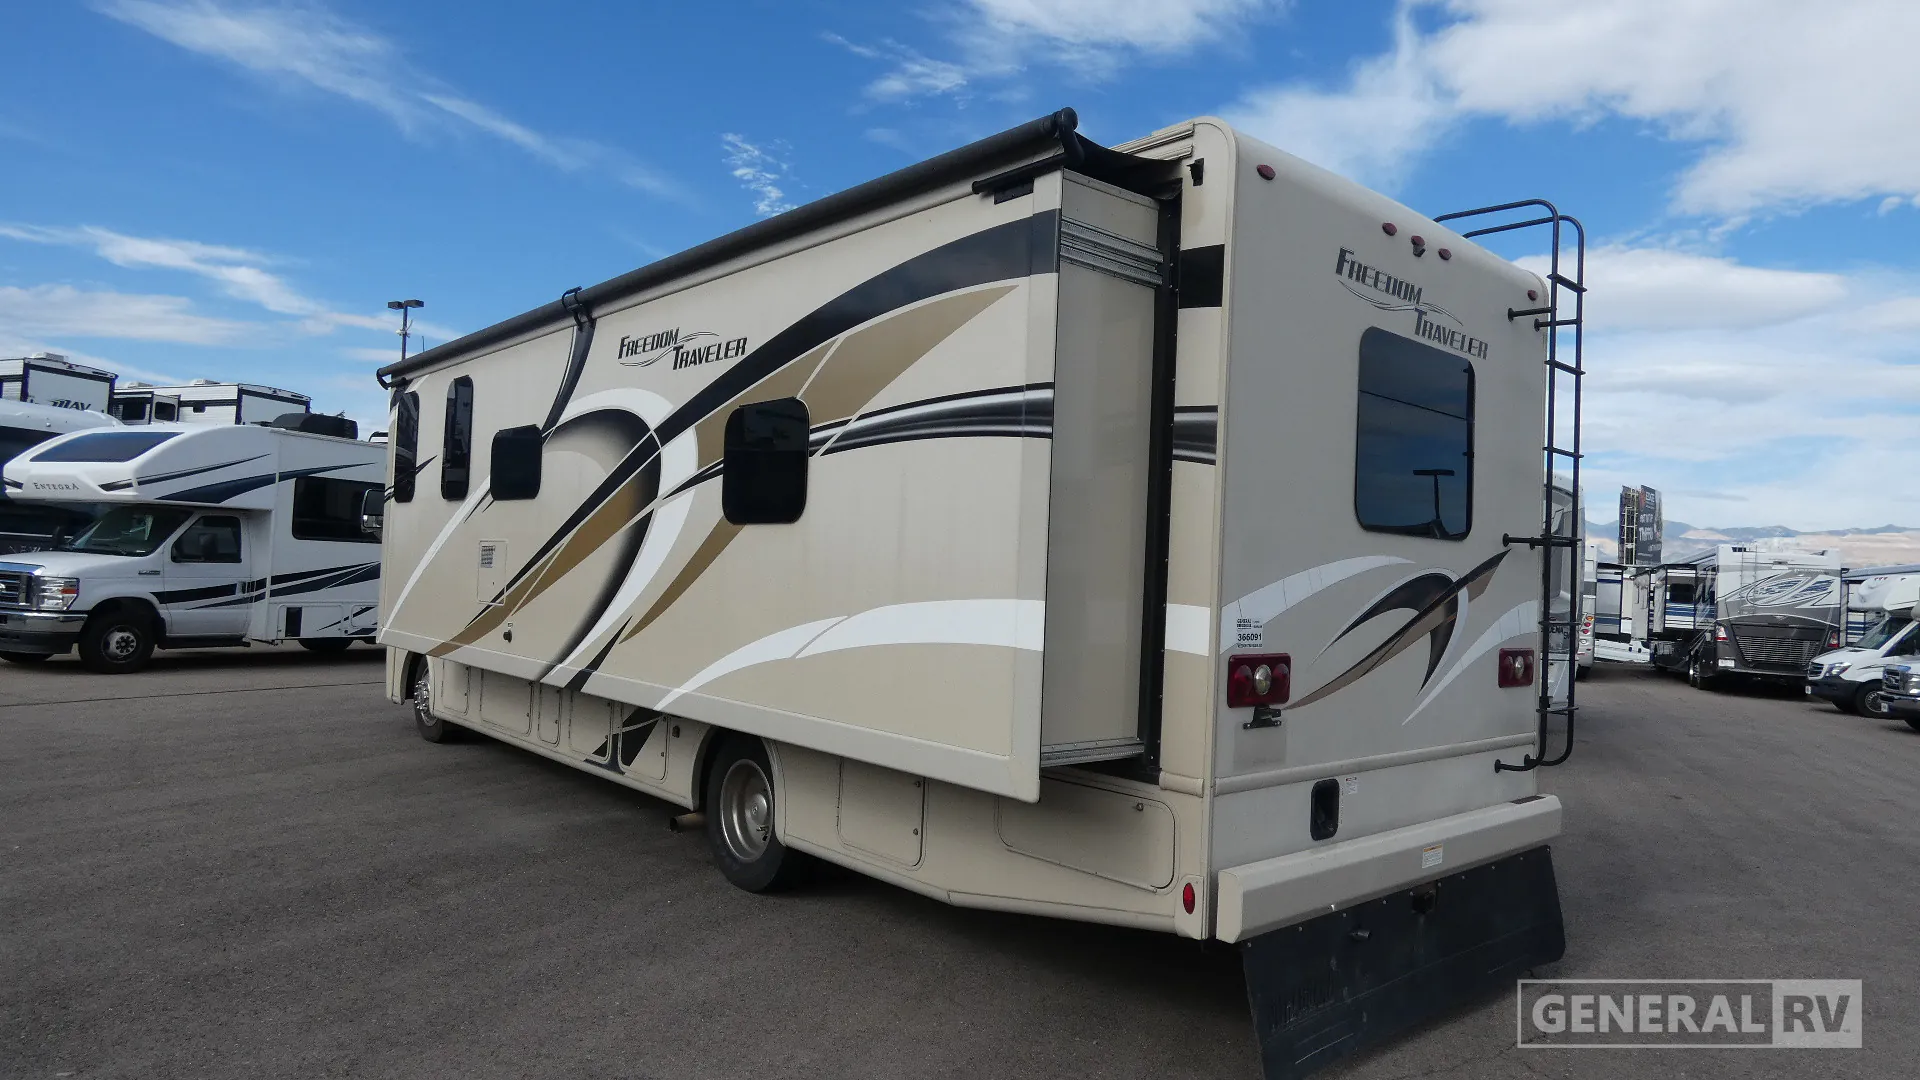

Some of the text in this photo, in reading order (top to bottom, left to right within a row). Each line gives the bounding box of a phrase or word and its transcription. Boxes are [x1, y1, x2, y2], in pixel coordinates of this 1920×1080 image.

[1335, 247, 1423, 305] FREEDOM
[618, 327, 680, 359] FREEDOM
[1414, 308, 1489, 360] TRAVELER
[672, 337, 748, 370] TRAVELER
[33, 482, 79, 490] ENTEGRA
[1237, 633, 1262, 641] 366091
